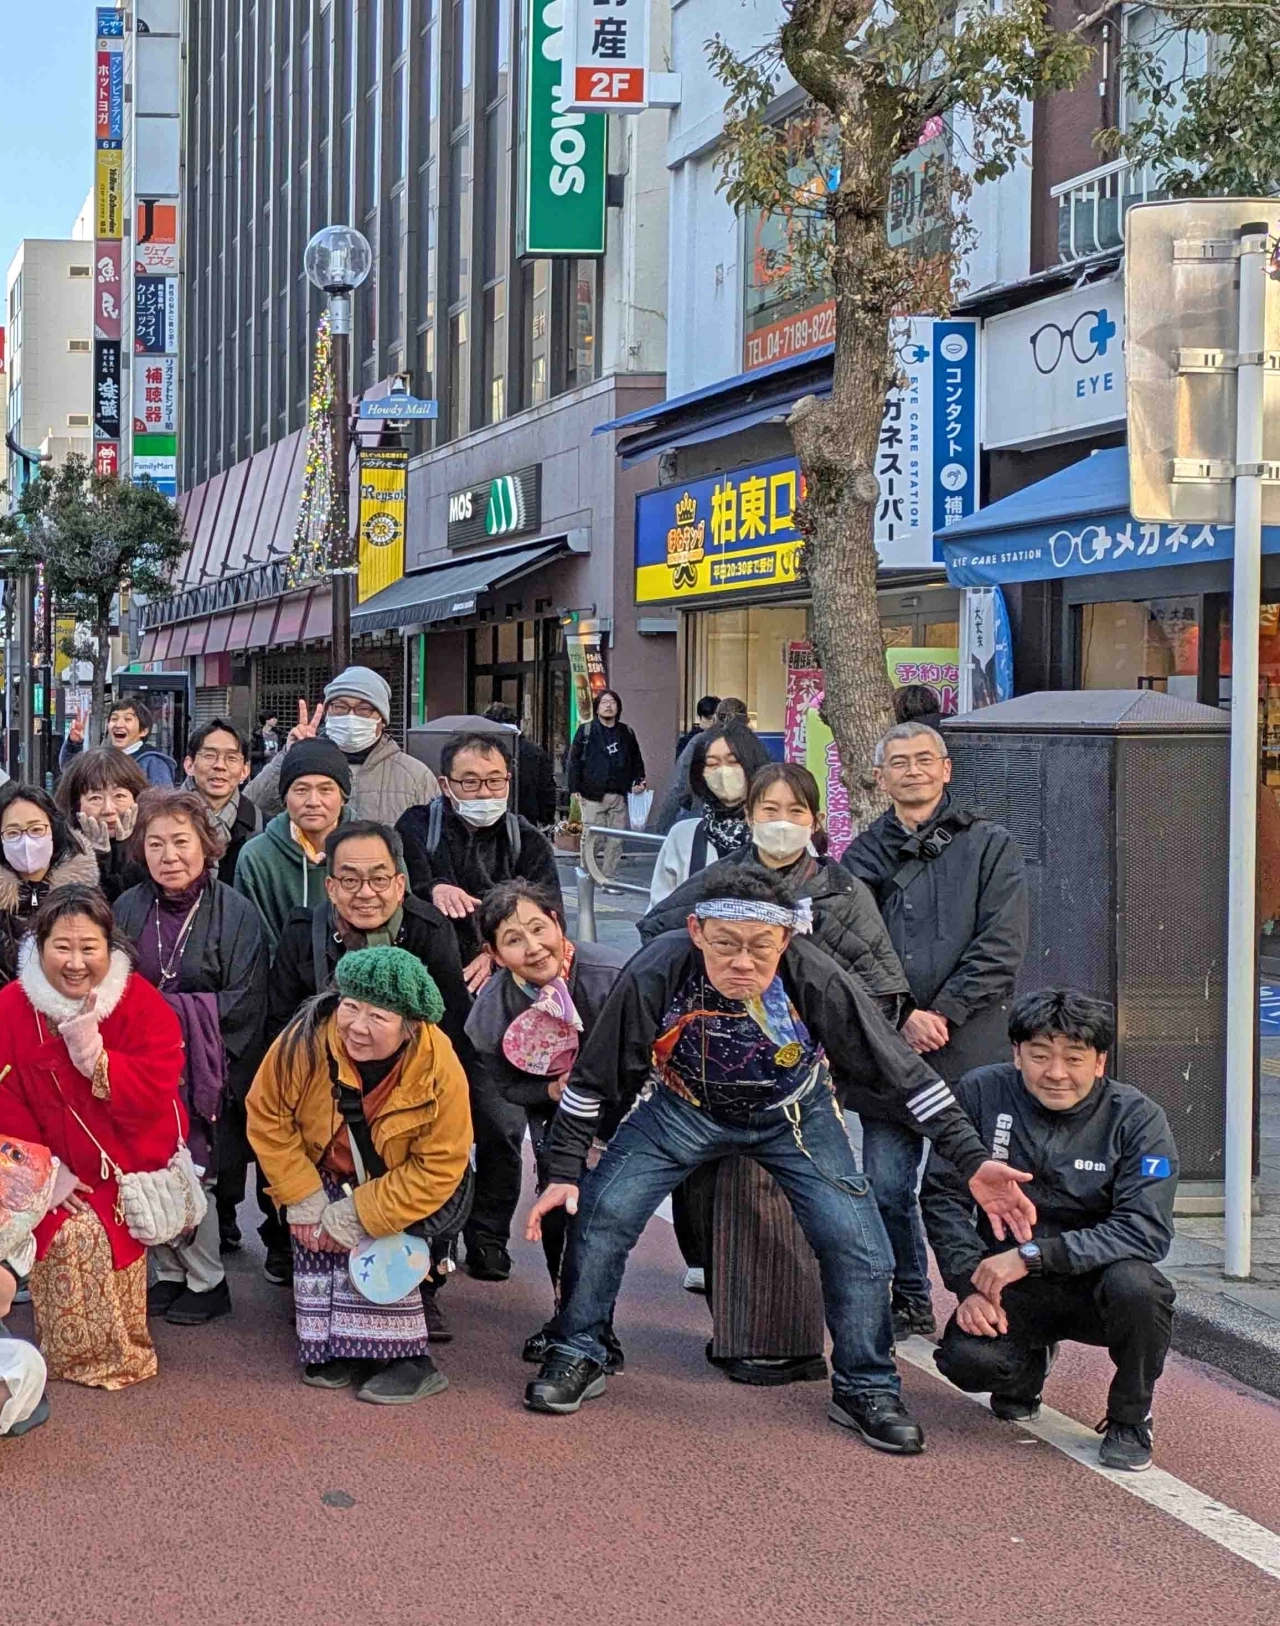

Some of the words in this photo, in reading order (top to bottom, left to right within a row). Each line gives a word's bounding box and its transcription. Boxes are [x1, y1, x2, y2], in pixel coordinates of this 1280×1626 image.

[591, 0, 628, 59] 産
[98, 65, 109, 125] ホットヨガ
[111, 56, 122, 133] マシンピラティス
[589, 72, 630, 98] 2F
[102, 140, 117, 149] 6F
[109, 168, 117, 192] Yellow
[109, 193, 118, 234] Submarine
[144, 246, 170, 256] ジェイ
[145, 256, 175, 266] エステ
[97, 256, 119, 320] 魚民
[136, 284, 146, 336] クリニック
[146, 284, 156, 346] メンズライフ
[98, 377, 119, 419] 楽蔵
[145, 367, 162, 423] 補聴器
[910, 376, 919, 405] EYE
[1076, 372, 1114, 398] EYE
[367, 404, 403, 416] Howdy
[405, 403, 431, 414] Mall
[945, 367, 962, 458] コンタクト
[135, 421, 144, 430] 2F
[910, 413, 919, 453] CARE
[134, 462, 174, 472] FamilyMart
[361, 484, 407, 503] Reysol
[448, 491, 473, 523] MOS
[710, 469, 796, 546] 柏東口
[910, 460, 919, 528] STATION
[713, 556, 774, 580] 平日20:30まで受付
[953, 556, 967, 569] EYE
[971, 553, 997, 566] CARE
[1000, 548, 1042, 563] STATION
[1074, 1159, 1106, 1172] 60th
[1145, 1158, 1161, 1175] 7
